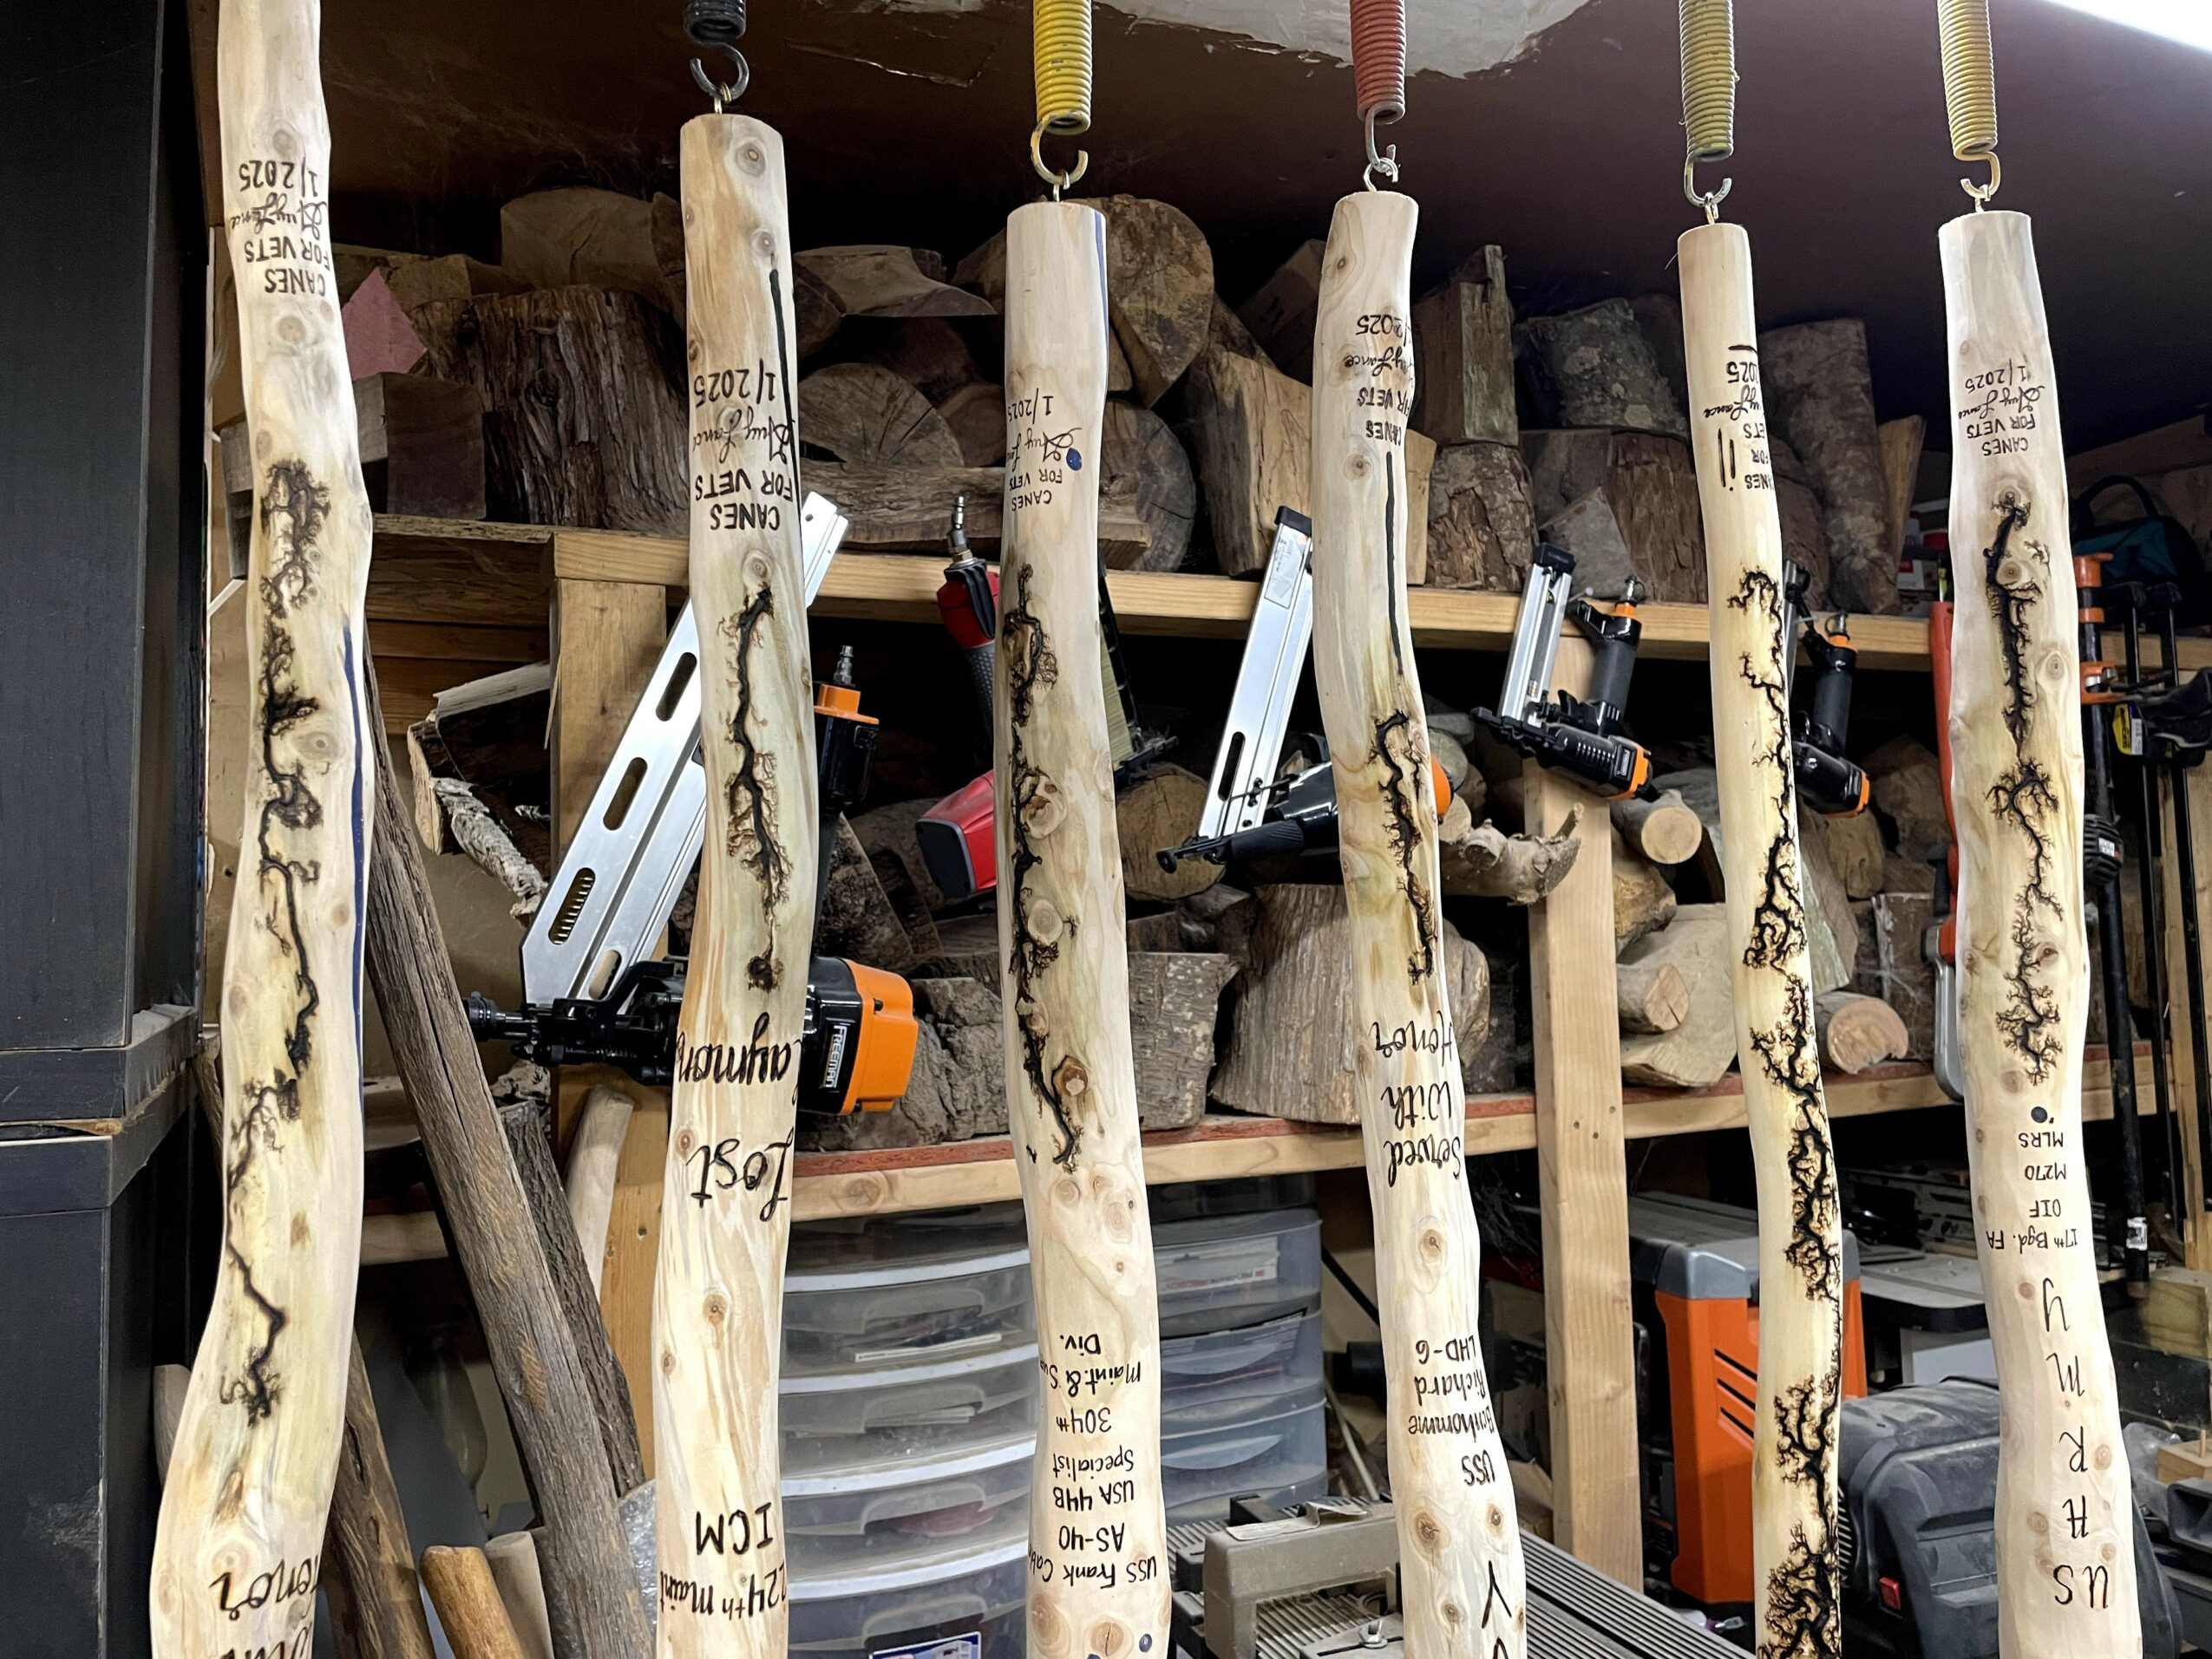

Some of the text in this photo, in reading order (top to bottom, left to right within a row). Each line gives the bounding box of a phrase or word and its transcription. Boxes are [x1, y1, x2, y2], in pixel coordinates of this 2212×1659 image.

[244, 236, 330, 271] FOR VETS
[265, 268, 325, 295] CANES
[693, 358, 776, 408] 1/2025
[1965, 358, 2027, 394] 1/2025
[1008, 388, 1053, 424] 1/2025
[1358, 388, 1393, 410] VETS
[1743, 423, 1765, 439] ETS
[1967, 414, 2036, 439] FOR VETS
[1981, 437, 2028, 456] CANES
[695, 469, 793, 502] FOR VETS
[1009, 469, 1062, 491] FOR VETS
[1744, 474, 1774, 489] ANES
[1011, 490, 1051, 511] CANES
[710, 503, 780, 531] CANES
[1369, 1010, 1453, 1067] Honor
[825, 1025, 847, 1088] FREEMAN
[1380, 1081, 1452, 1131] With
[2018, 1132, 2064, 1147] MLRS
[686, 1126, 794, 1222] Lost
[1384, 1133, 1461, 1188] Served
[2024, 1162, 2066, 1180] M270
[2029, 1199, 2061, 1218] OIF
[1985, 1225, 2078, 1254] 17th Bgd. FA
[1059, 1333, 1101, 1355] Div.
[1415, 1335, 1476, 1365] LHD-6
[1065, 1369, 1080, 1397] &
[1084, 1361, 1141, 1394] Maint.
[1414, 1368, 1485, 1406] Richard
[1056, 1408, 1112, 1433] 304th
[1052, 1445, 1134, 1482] Specialist
[1461, 1449, 1495, 1487] USS
[1052, 1480, 1134, 1512] USA 44B
[696, 1502, 774, 1556] ICM
[1058, 1523, 1125, 1552] AS-40
[1063, 1563, 1116, 1589] Frank
[1126, 1555, 1157, 1583] USS
[2052, 1565, 2109, 1610] US
